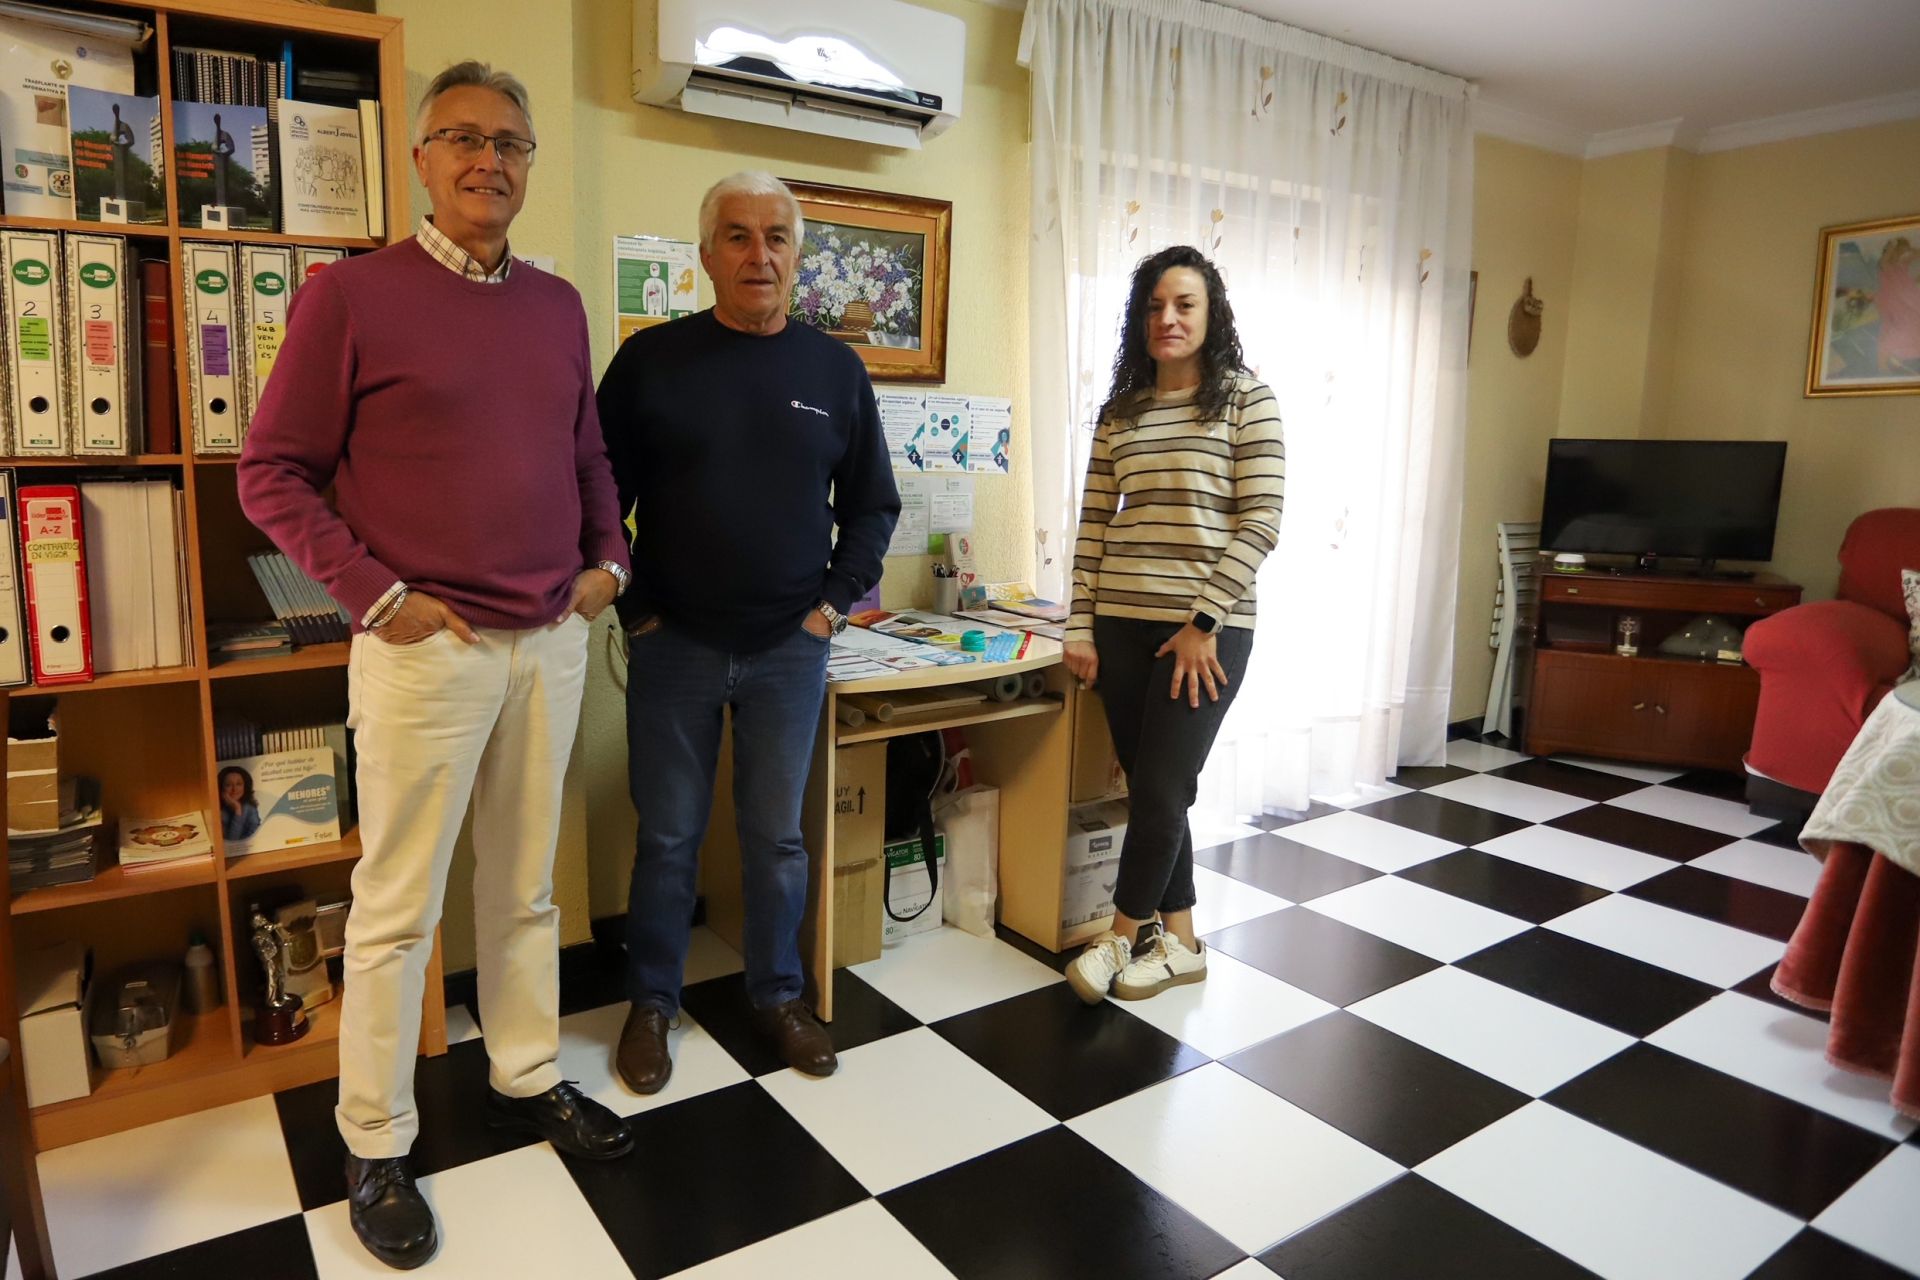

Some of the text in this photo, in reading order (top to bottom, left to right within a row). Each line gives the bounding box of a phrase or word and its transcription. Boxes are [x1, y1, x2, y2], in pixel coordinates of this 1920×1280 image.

[22, 301, 38, 316] 2
[90, 304, 102, 319] 3
[207, 310, 218, 323] 4
[263, 311, 274, 323] 5
[256, 325, 276, 333] SUB
[40, 525, 61, 535] A-Z
[28, 541, 79, 552] CONTRATOS
[31, 552, 42, 560] EN
